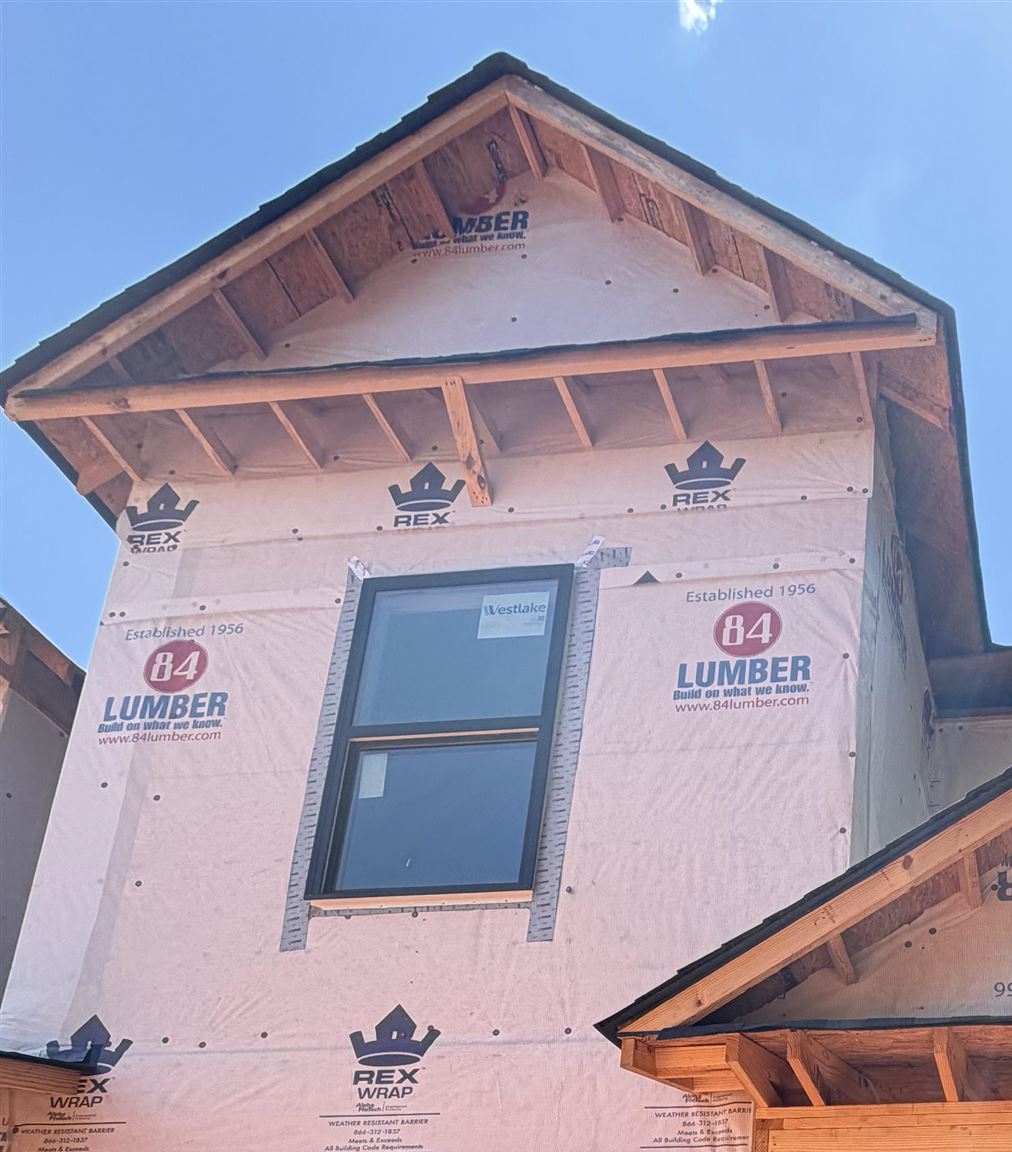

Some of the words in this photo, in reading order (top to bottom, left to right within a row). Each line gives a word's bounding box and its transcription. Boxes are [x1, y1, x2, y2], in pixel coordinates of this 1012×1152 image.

[453, 210, 529, 234] MBER
[672, 489, 731, 507] REX
[393, 511, 450, 527] REX
[127, 531, 180, 545] REX
[686, 586, 773, 602] Established
[780, 583, 816, 596] 1956
[483, 603, 546, 617] Westlake
[125, 625, 205, 641] Established
[209, 623, 244, 636] 1956
[722, 612, 773, 646] 84
[150, 650, 201, 682] 84
[677, 655, 811, 688] LUMBER
[673, 688, 701, 700] Build
[705, 688, 720, 699] on
[723, 686, 752, 697] what
[755, 685, 772, 695] we
[775, 683, 810, 694] know.
[103, 692, 229, 721] LUMBER
[675, 696, 809, 712] www.84lumber.com
[98, 722, 123, 733] Build
[126, 722, 140, 730] on
[143, 721, 170, 730] what
[174, 721, 190, 730] we
[192, 719, 223, 729] know.
[98, 731, 221, 745] www.84lumber.com
[353, 1069, 420, 1085] REX
[77, 1078, 110, 1093] EX
[357, 1087, 413, 1099] WRAP
[50, 1096, 103, 1108] WRAP
[691, 1109, 726, 1117] RESISTANT
